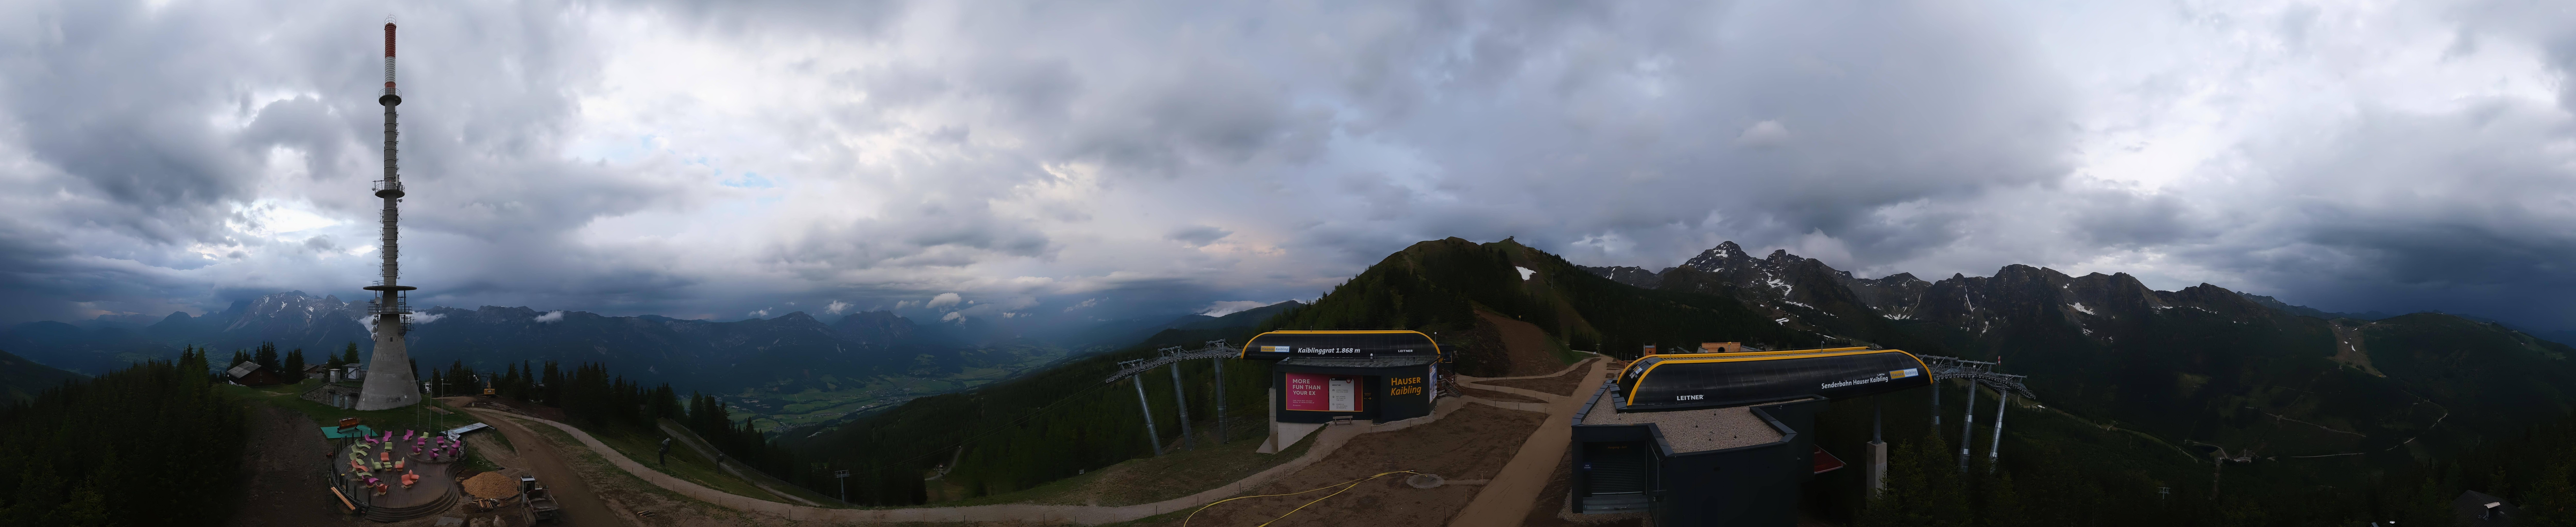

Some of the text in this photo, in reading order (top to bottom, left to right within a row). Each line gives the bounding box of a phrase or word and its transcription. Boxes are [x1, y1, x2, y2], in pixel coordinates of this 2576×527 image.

[1391, 377, 1421, 386] HAUSER
[1821, 380, 1852, 389] Senderbahn
[1391, 386, 1421, 396] Kaibling
